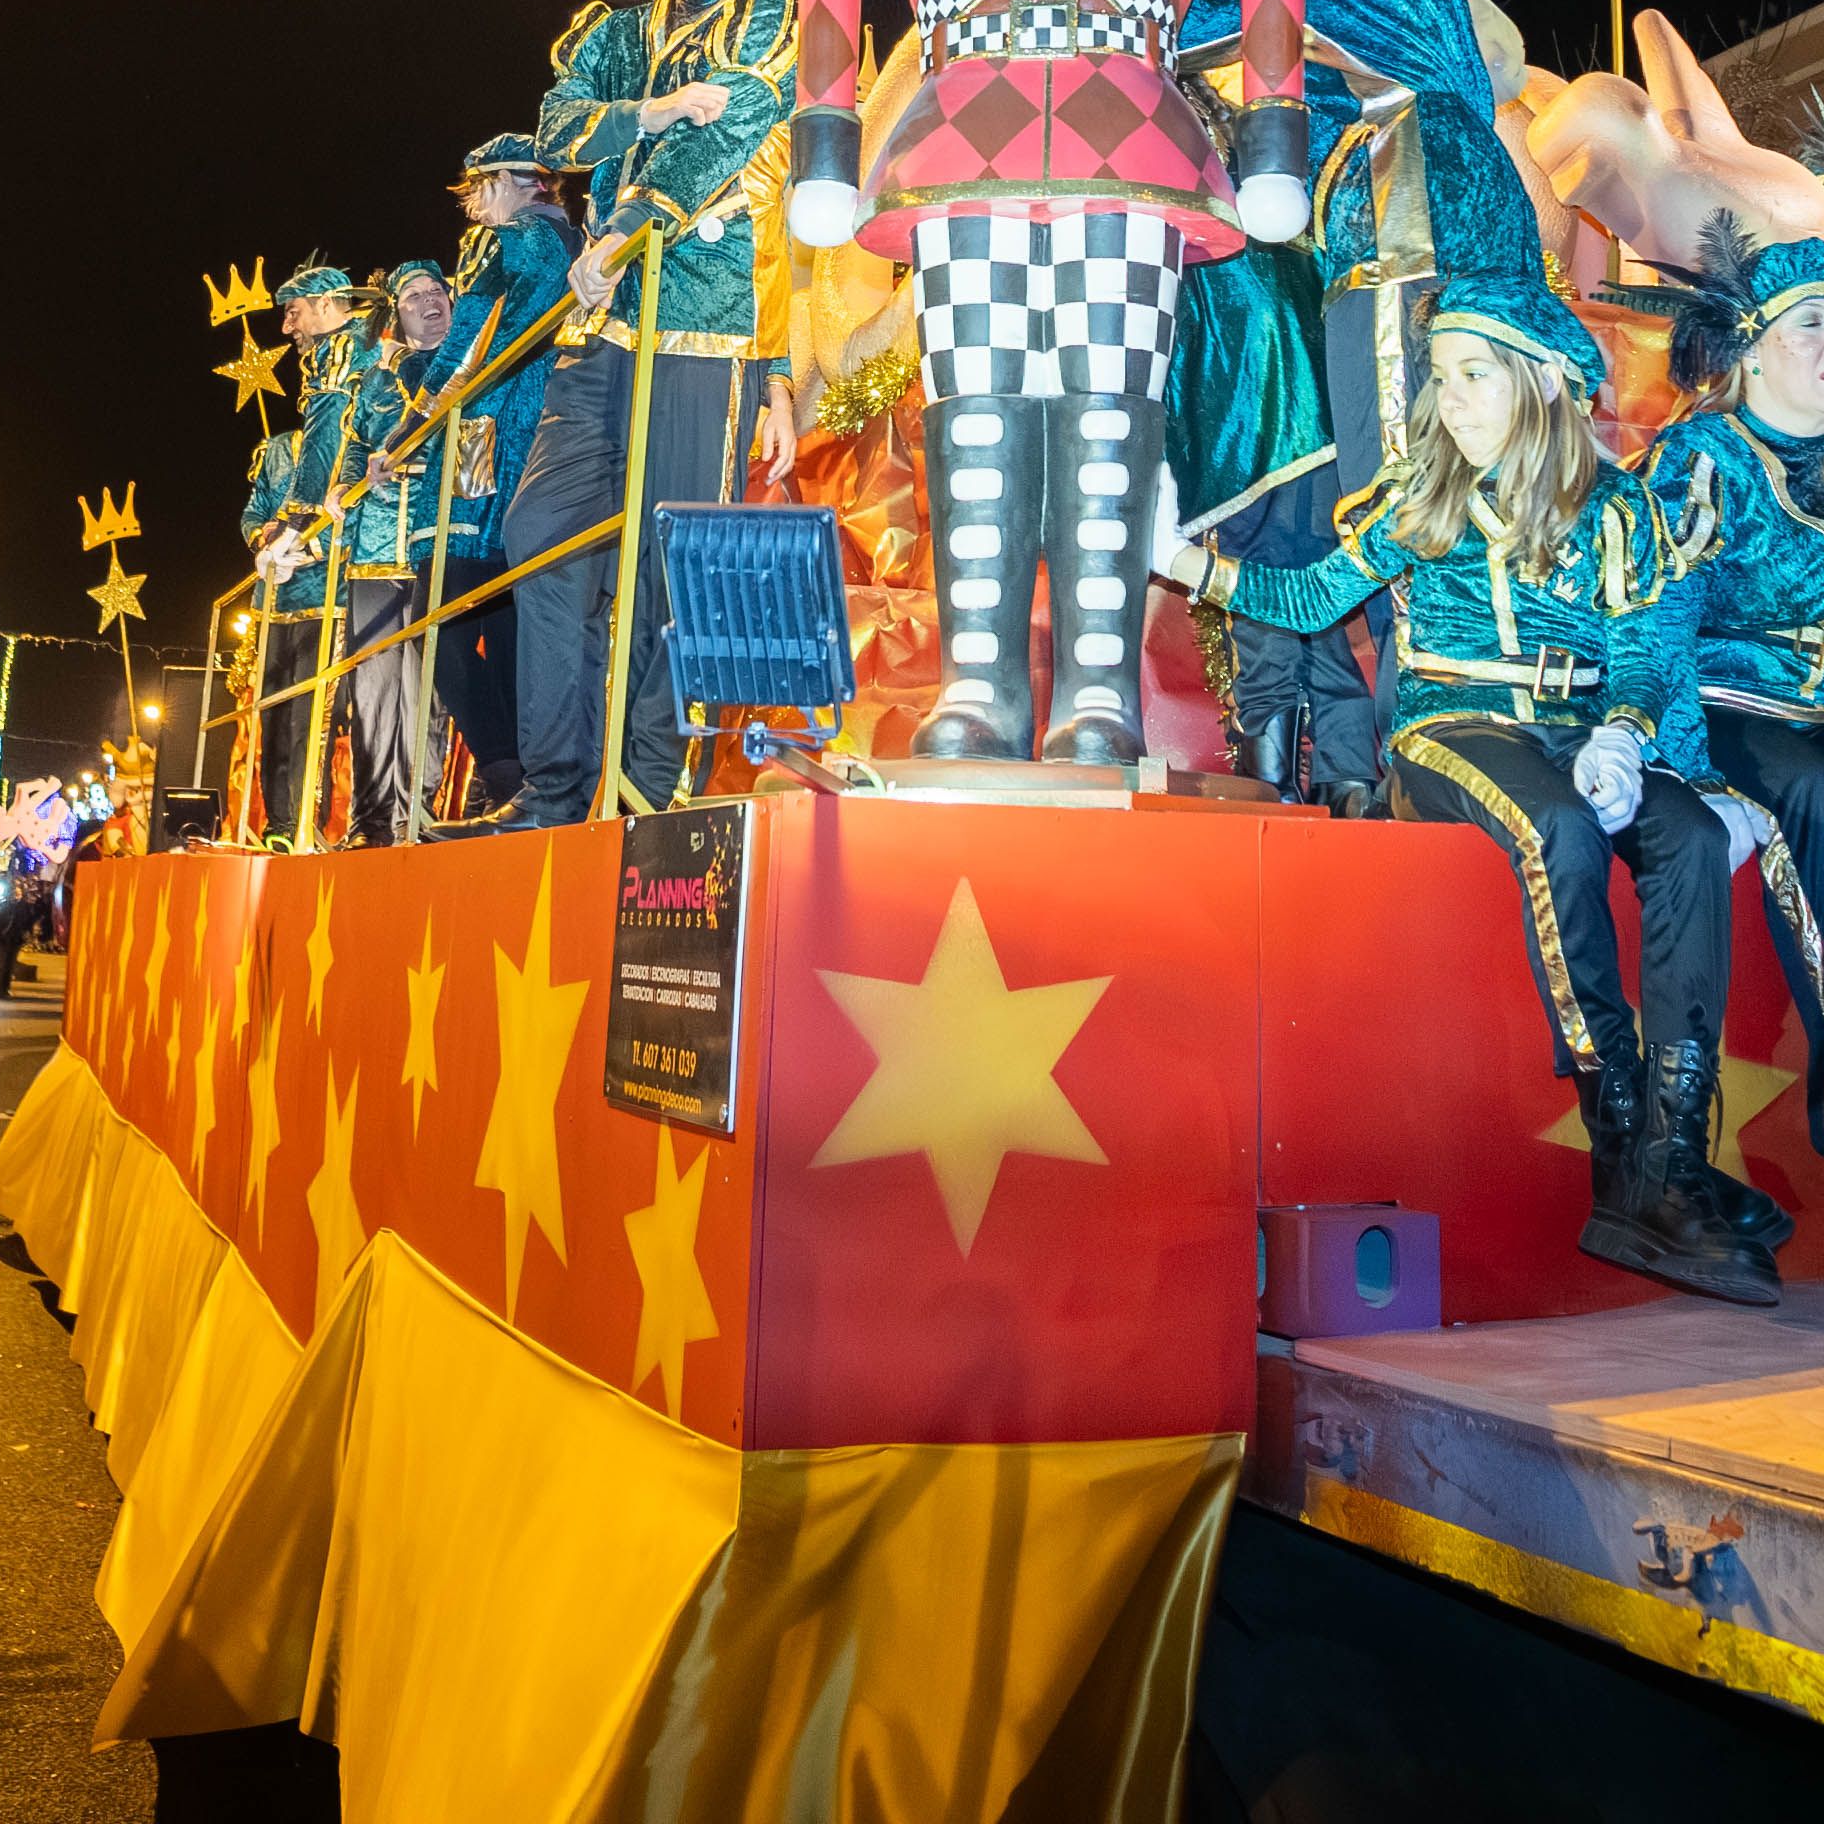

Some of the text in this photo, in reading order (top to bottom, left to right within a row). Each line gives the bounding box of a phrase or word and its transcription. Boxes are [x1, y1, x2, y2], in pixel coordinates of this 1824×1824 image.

[621, 912, 701, 928] DECORADOS
[642, 1043, 658, 1069] 607
[660, 1046, 676, 1074] 361
[678, 1049, 696, 1078] 039
[623, 1081, 702, 1114] www.planningdeco.com
